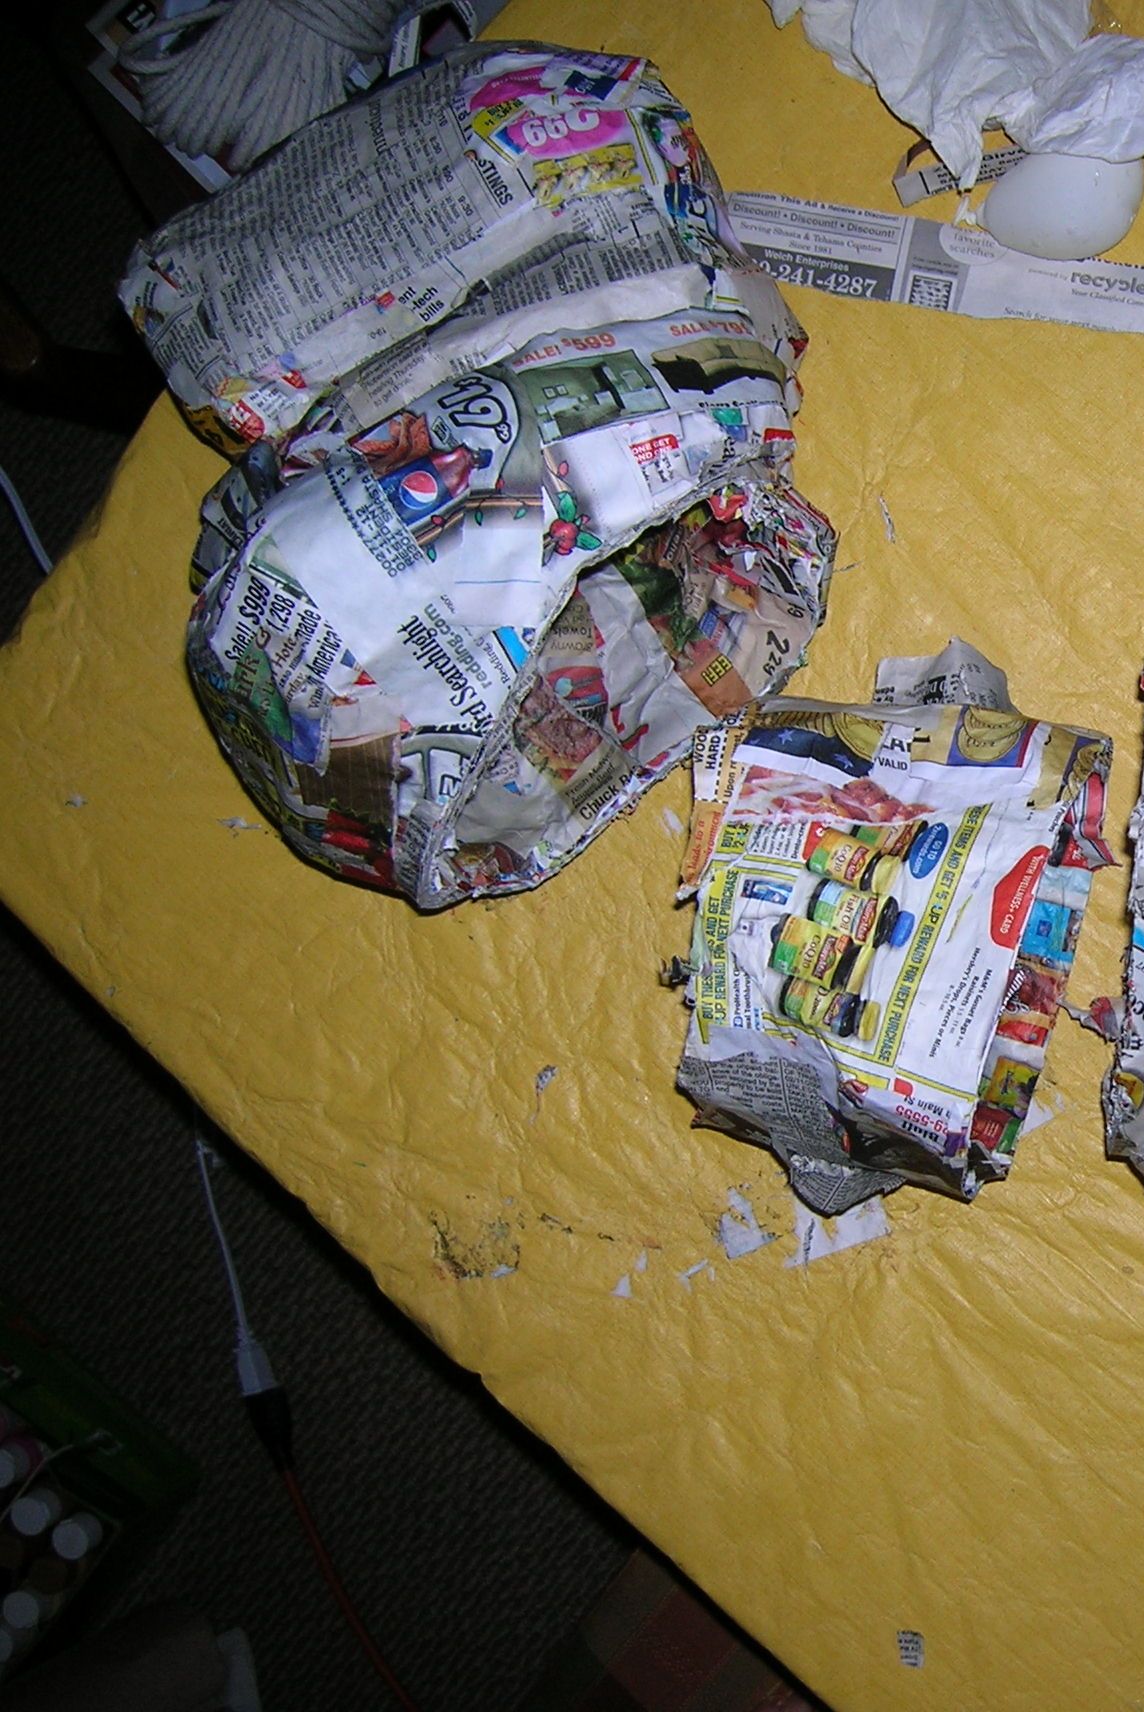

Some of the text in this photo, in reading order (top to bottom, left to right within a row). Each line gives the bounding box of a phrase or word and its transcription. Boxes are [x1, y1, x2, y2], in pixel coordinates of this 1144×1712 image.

[733, 203, 895, 238] Discount! Discount! Discount!
[764, 248, 850, 272] Welch Enterprises
[1071, 288, 1088, 298] Your
[1089, 290, 1125, 304] Classified
[419, 300, 444, 322] bills
[1004, 306, 1031, 318] Search
[561, 332, 616, 353] $599
[239, 575, 271, 626] $999
[705, 735, 721, 770] HARD
[578, 786, 620, 822] Chuck
[708, 896, 720, 914] GET
[706, 917, 717, 936] AND
[910, 923, 936, 964] REWARD
